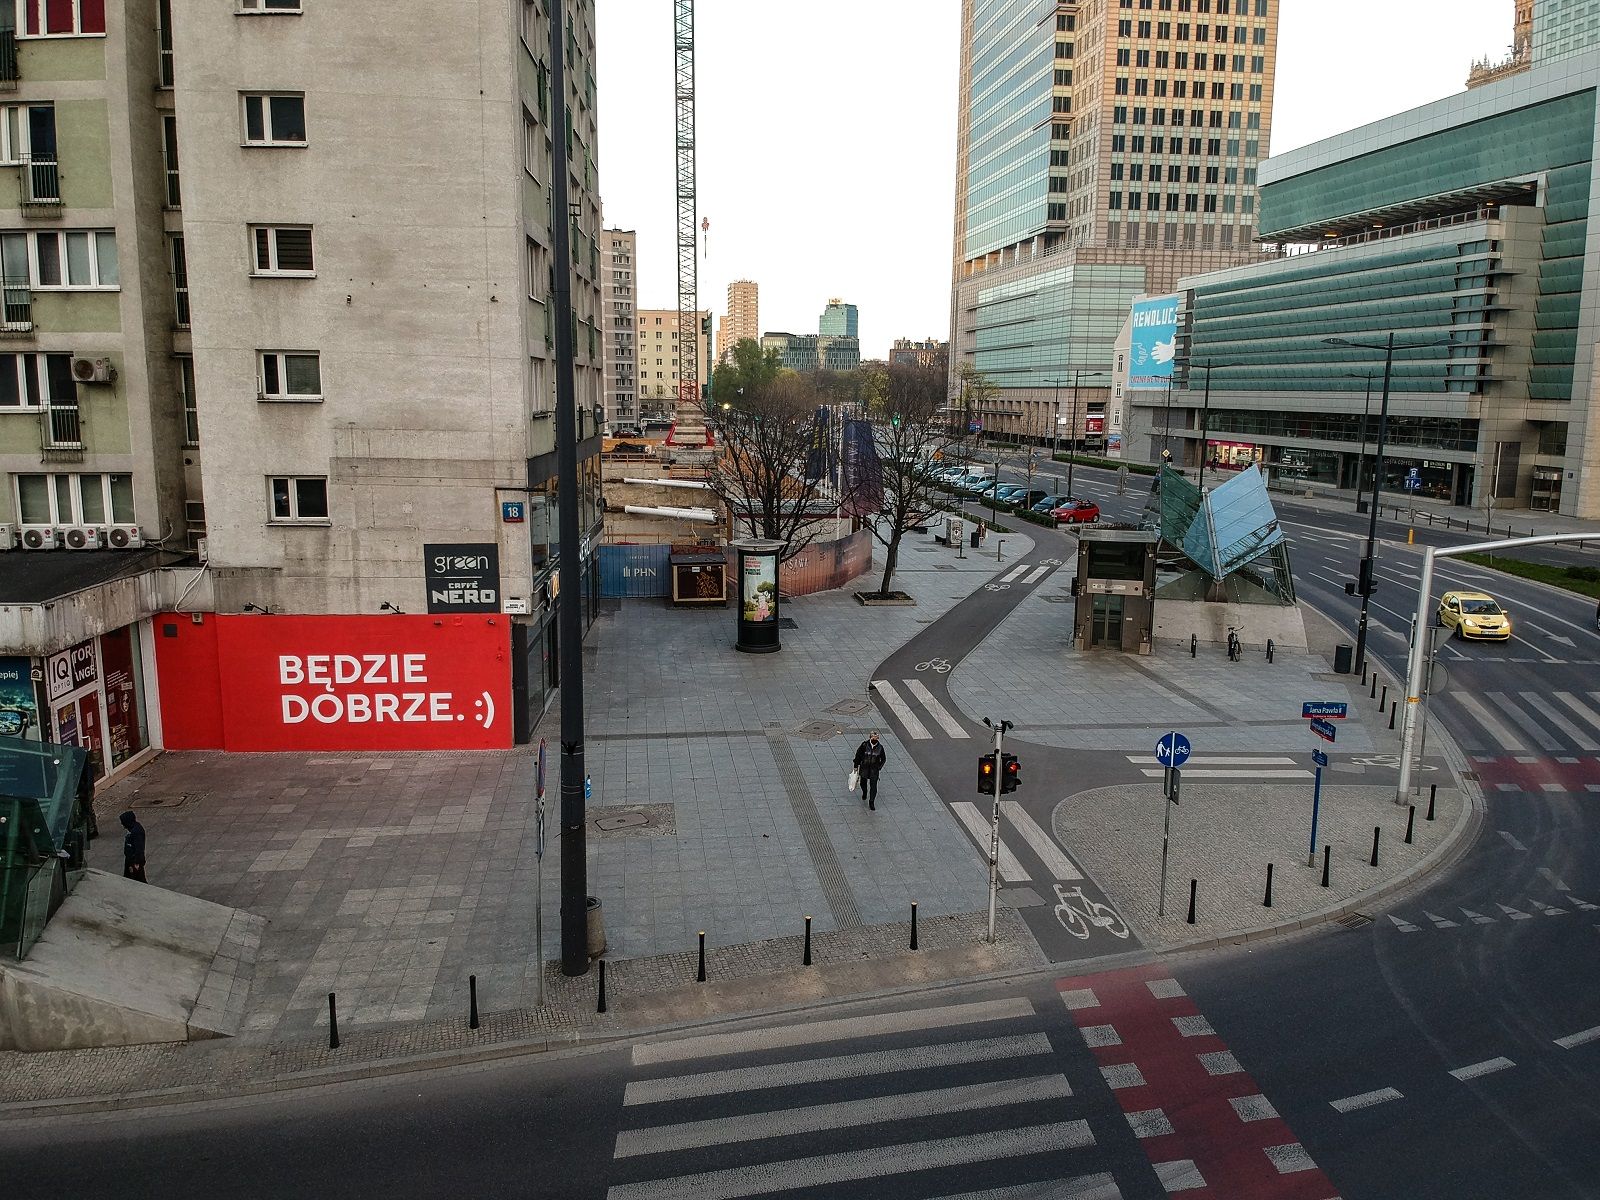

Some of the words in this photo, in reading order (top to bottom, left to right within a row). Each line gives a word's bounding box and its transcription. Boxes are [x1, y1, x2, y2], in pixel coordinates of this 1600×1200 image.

[507, 506, 519, 518] 18
[434, 556, 489, 573] green
[634, 567, 657, 577] PHN
[432, 590, 496, 604] NERO
[53, 657, 70, 684] IQ
[279, 653, 428, 692] BĘDZIE
[281, 692, 465, 724] DOBRZE.
[1322, 706, 1338, 714] Pawła
